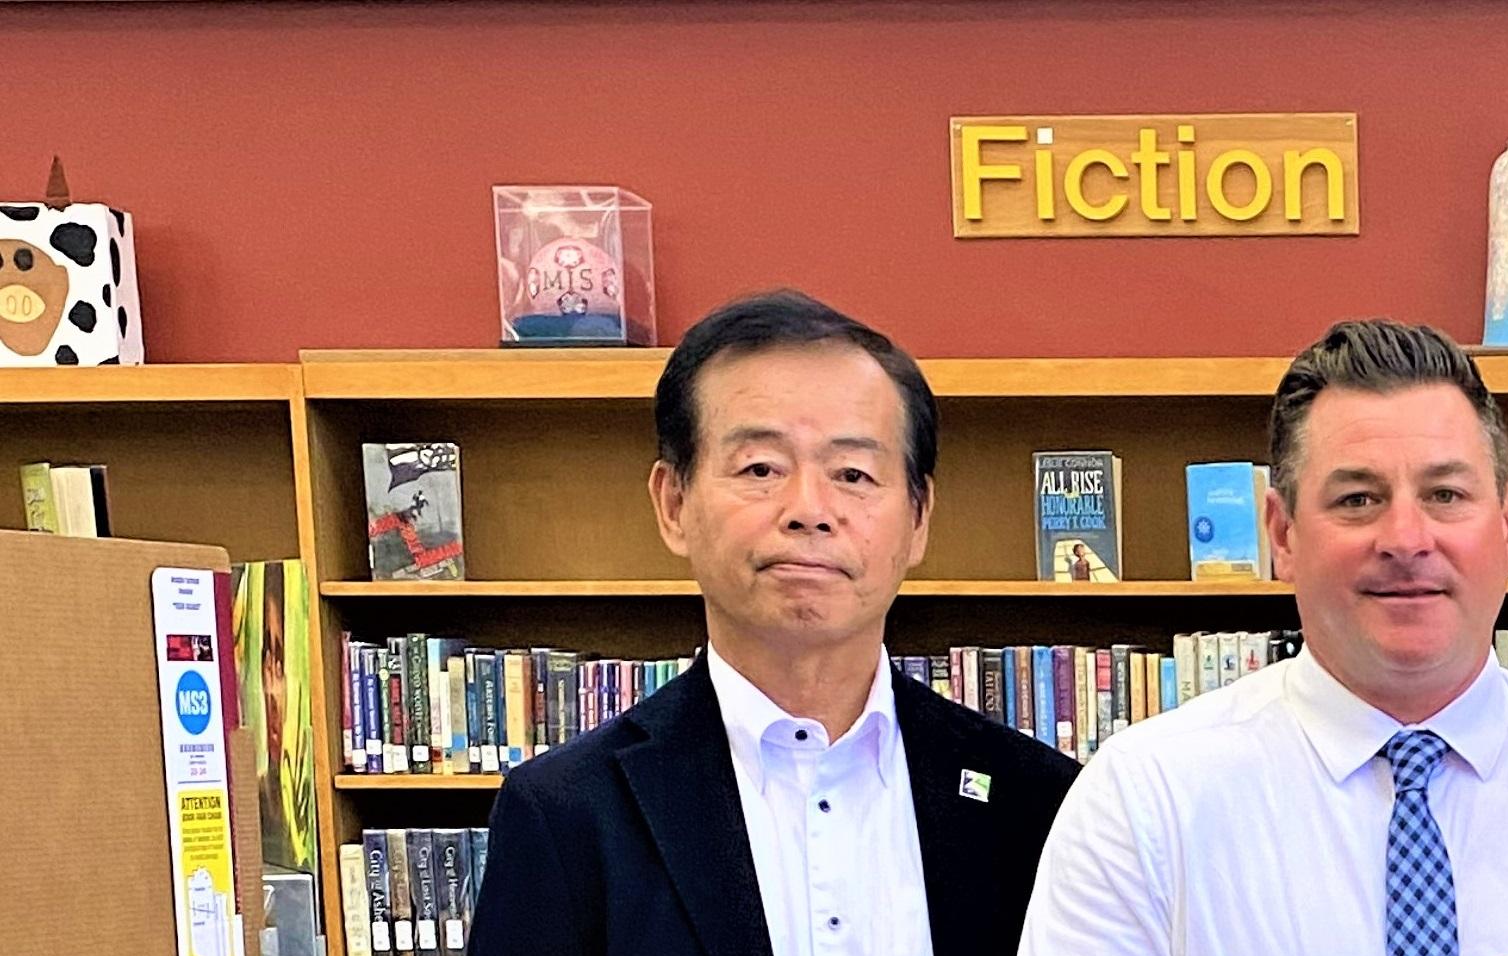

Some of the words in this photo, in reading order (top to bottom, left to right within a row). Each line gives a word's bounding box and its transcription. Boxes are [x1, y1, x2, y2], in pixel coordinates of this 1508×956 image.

[961, 125, 1345, 221] Fiction
[543, 268, 594, 292] MIS
[1041, 470, 1069, 495] ALL
[1071, 469, 1104, 496] RISE
[1041, 494, 1105, 516] HONORABLE
[179, 690, 208, 716] MS3
[373, 892, 386, 922] Ashe
